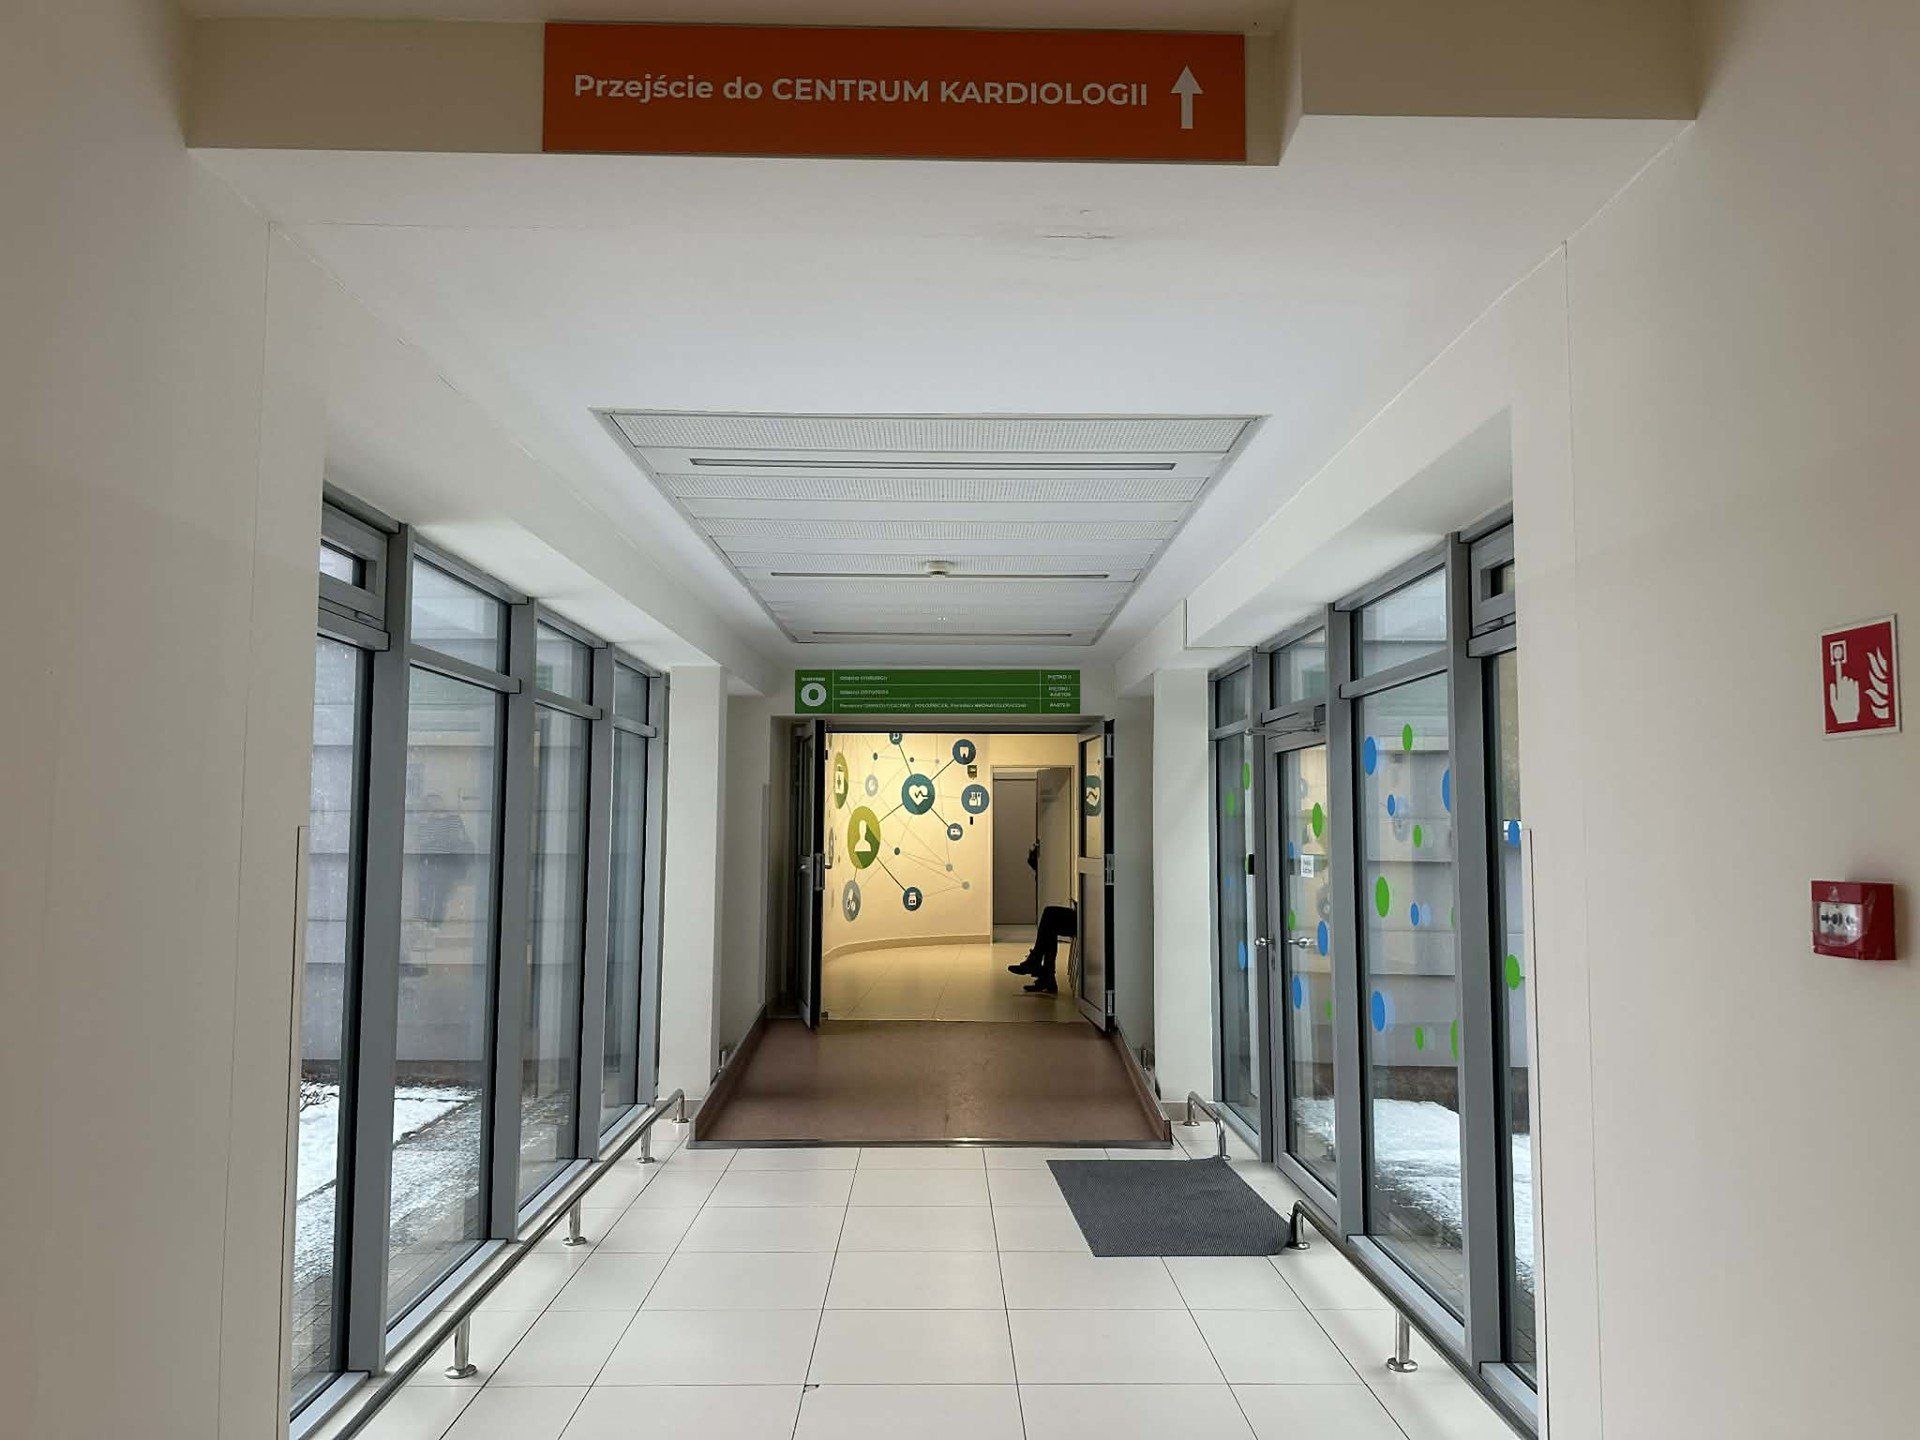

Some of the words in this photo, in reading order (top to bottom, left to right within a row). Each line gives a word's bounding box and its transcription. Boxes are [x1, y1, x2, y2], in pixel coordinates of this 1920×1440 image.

[575, 74, 713, 103] Przejście
[723, 77, 763, 99] do
[771, 79, 929, 102] CENTRUM
[940, 81, 1147, 106] KARDIOLOGII
